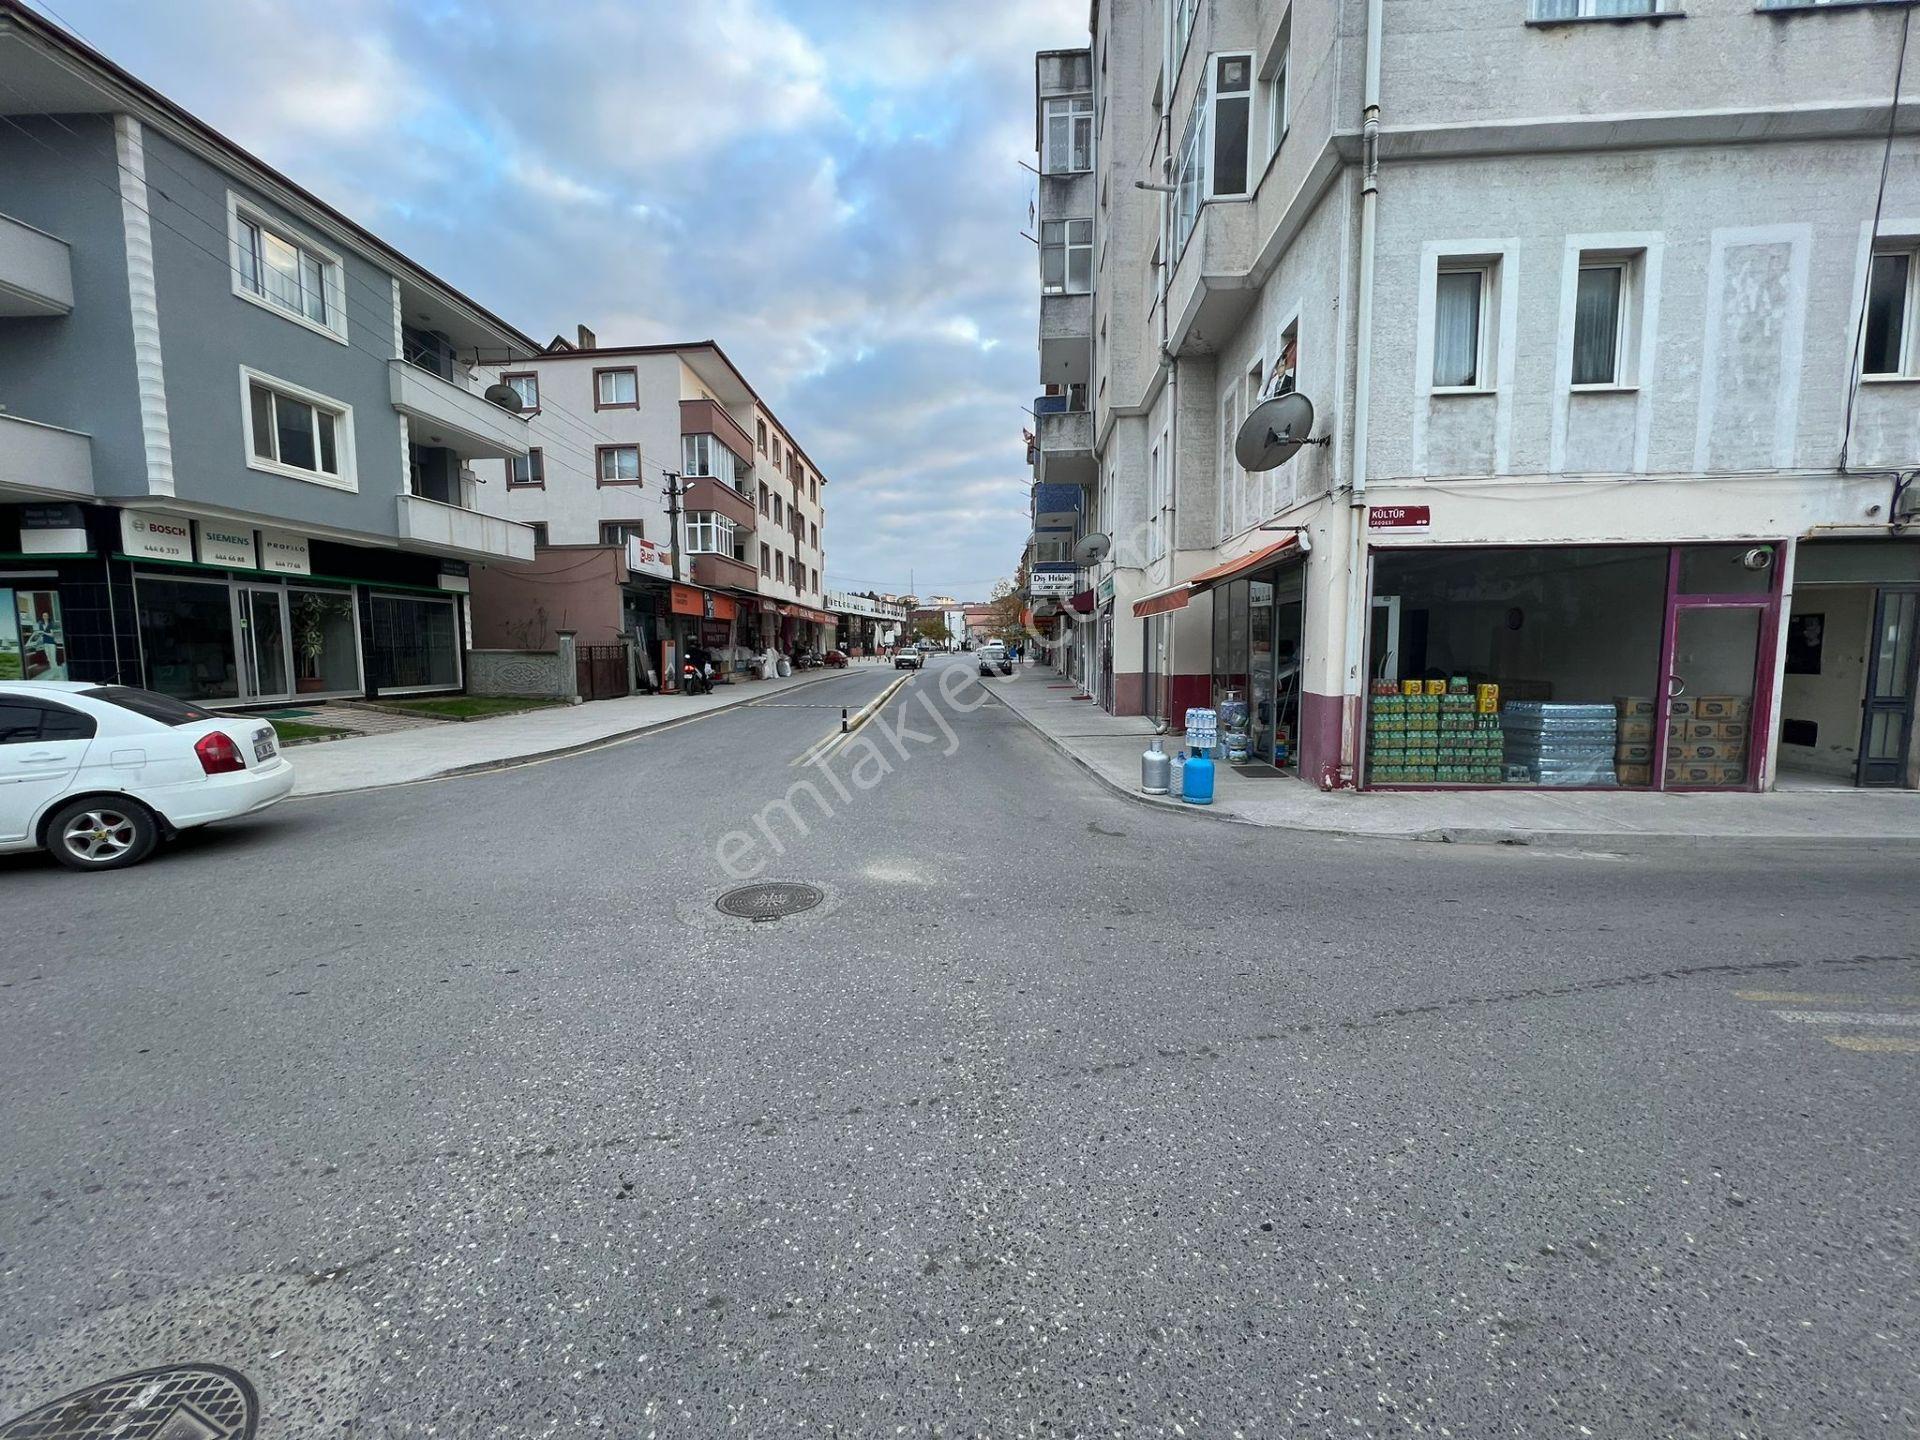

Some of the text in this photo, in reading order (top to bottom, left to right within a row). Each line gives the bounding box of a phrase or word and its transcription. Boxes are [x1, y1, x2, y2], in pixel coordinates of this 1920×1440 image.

[1372, 508, 1406, 519] KÜLTÜR
[149, 523, 187, 537] BOSCH
[206, 532, 250, 546] SIEMENS
[144, 544, 158, 552] 444
[166, 547, 180, 555] 333
[1033, 574, 1046, 584] Diş
